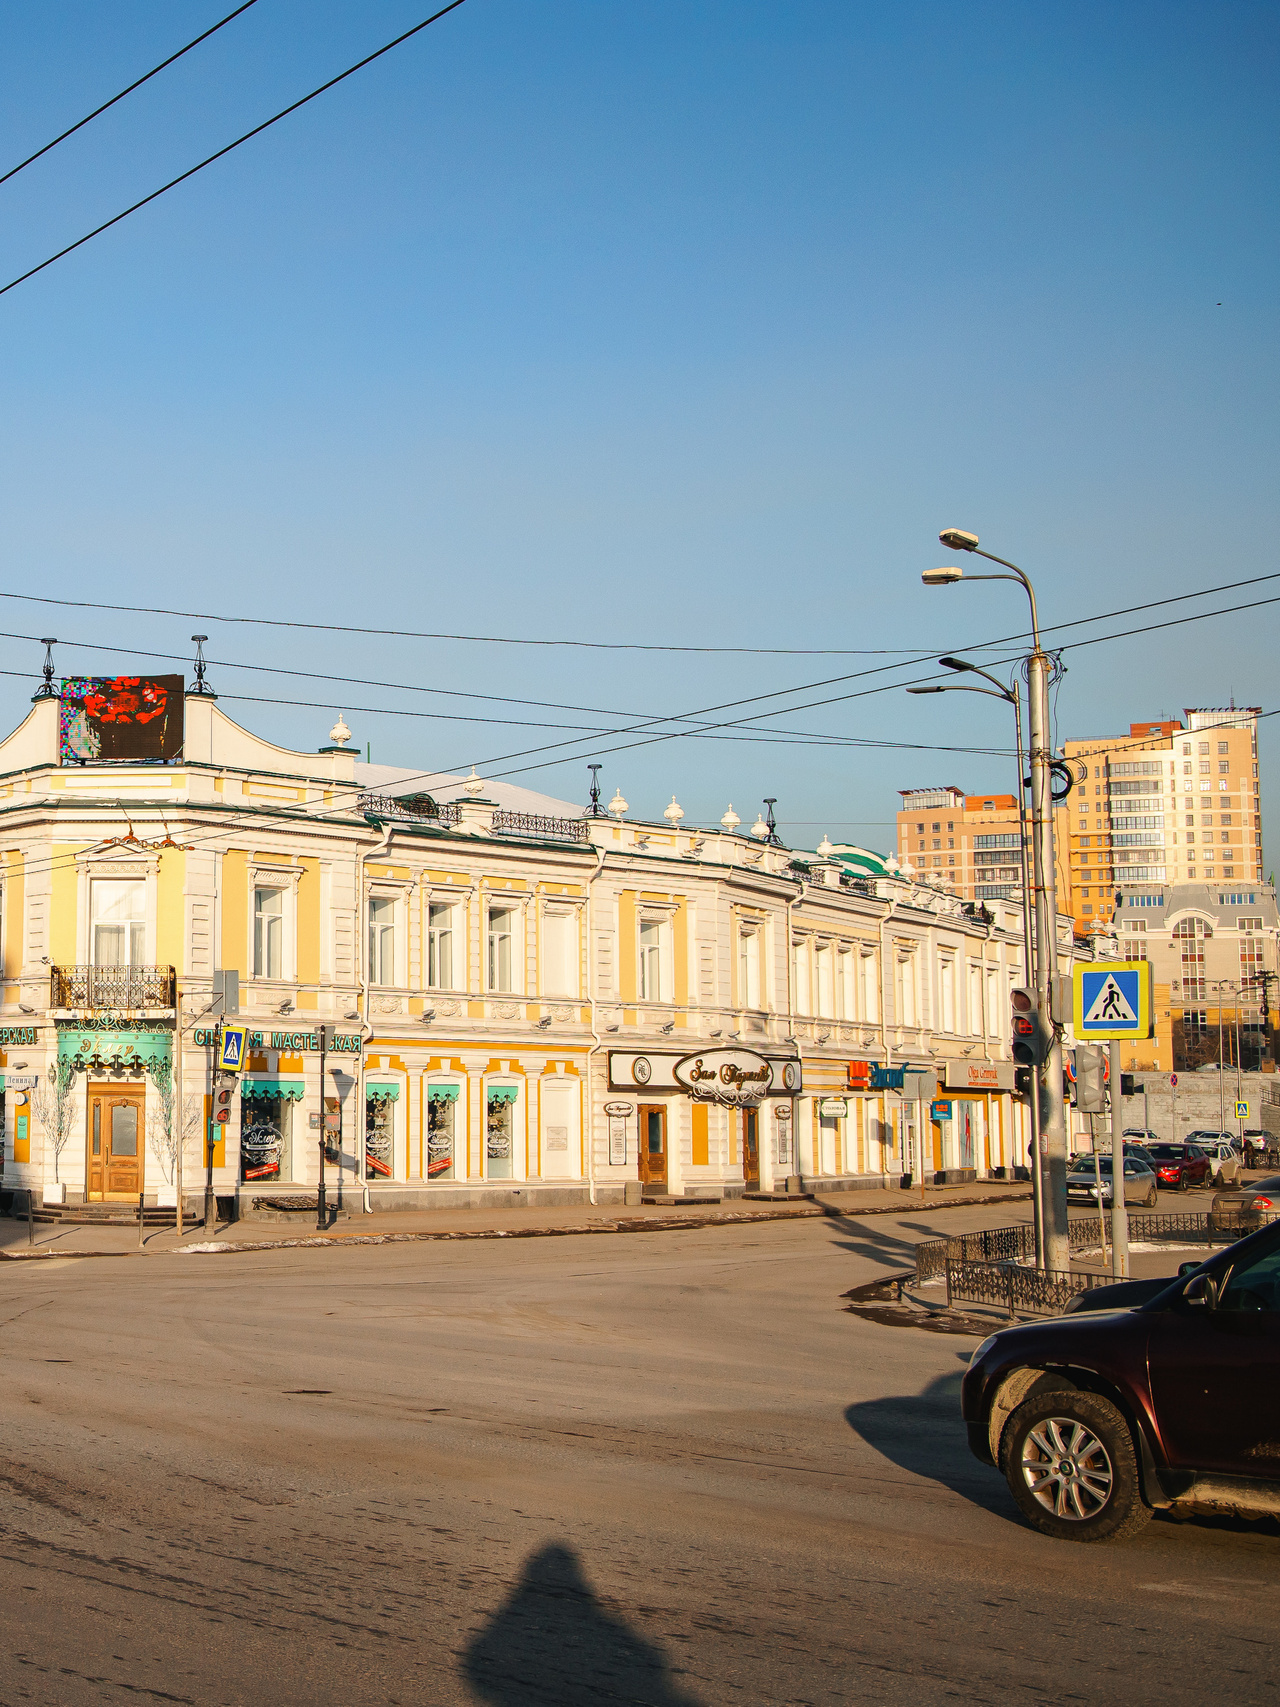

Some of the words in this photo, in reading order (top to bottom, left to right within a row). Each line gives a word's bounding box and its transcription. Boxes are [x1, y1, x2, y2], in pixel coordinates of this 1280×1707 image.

[80, 1037, 134, 1057] Эклер
[272, 1032, 361, 1051] МАСТЕСКАЯ
[7, 1076, 31, 1084] Ленина
